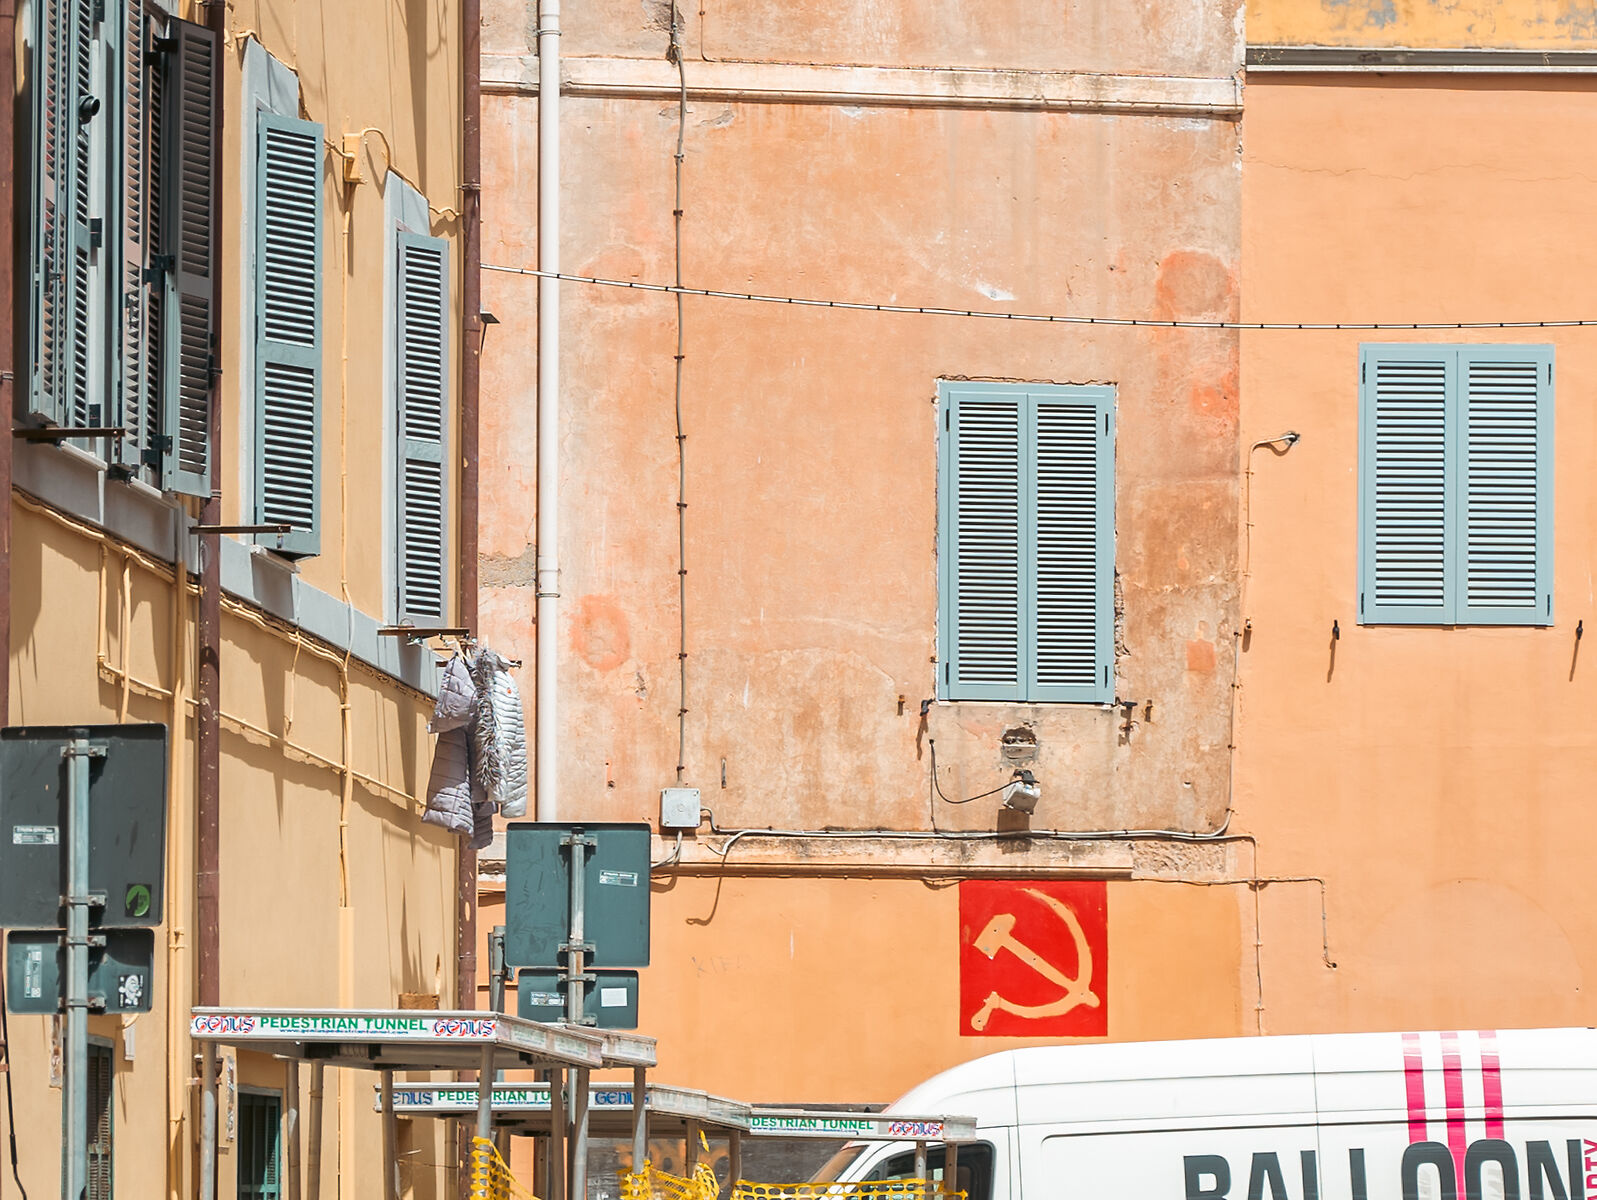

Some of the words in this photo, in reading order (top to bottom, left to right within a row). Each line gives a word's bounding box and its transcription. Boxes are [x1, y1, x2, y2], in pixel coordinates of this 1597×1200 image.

[260, 1017, 358, 1030] PEDESTRIAN
[364, 1018, 427, 1030] TUNNEL
[438, 1090, 527, 1101] PEDESRIAN
[751, 1117, 817, 1128] DESTRIAN
[823, 1120, 874, 1130] TUNNEL
